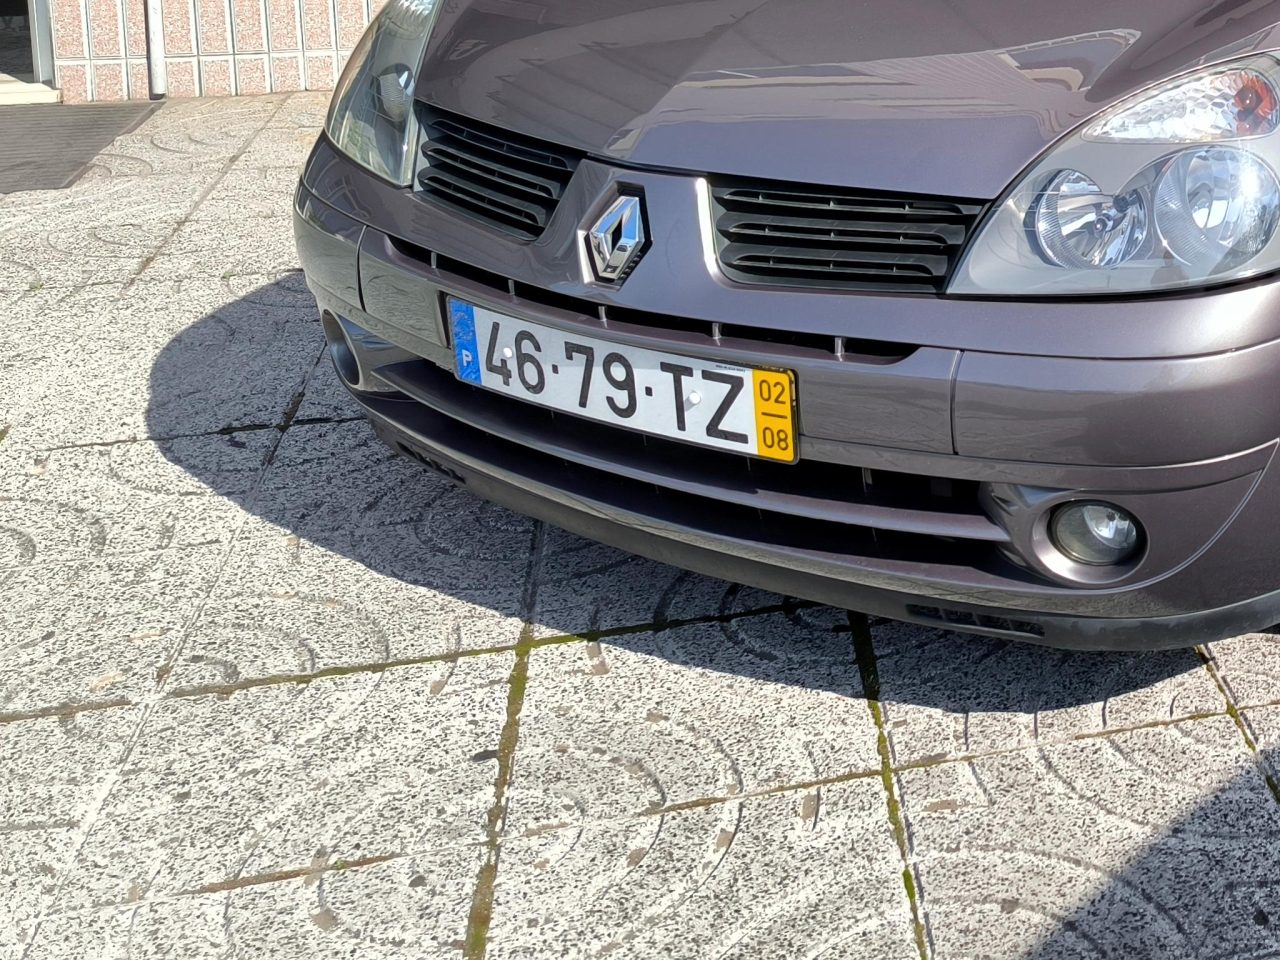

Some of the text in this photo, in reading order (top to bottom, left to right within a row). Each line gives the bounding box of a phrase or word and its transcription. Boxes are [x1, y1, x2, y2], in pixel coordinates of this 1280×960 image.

[461, 349, 473, 367] P
[758, 379, 786, 405] 02
[762, 426, 789, 451] 08
